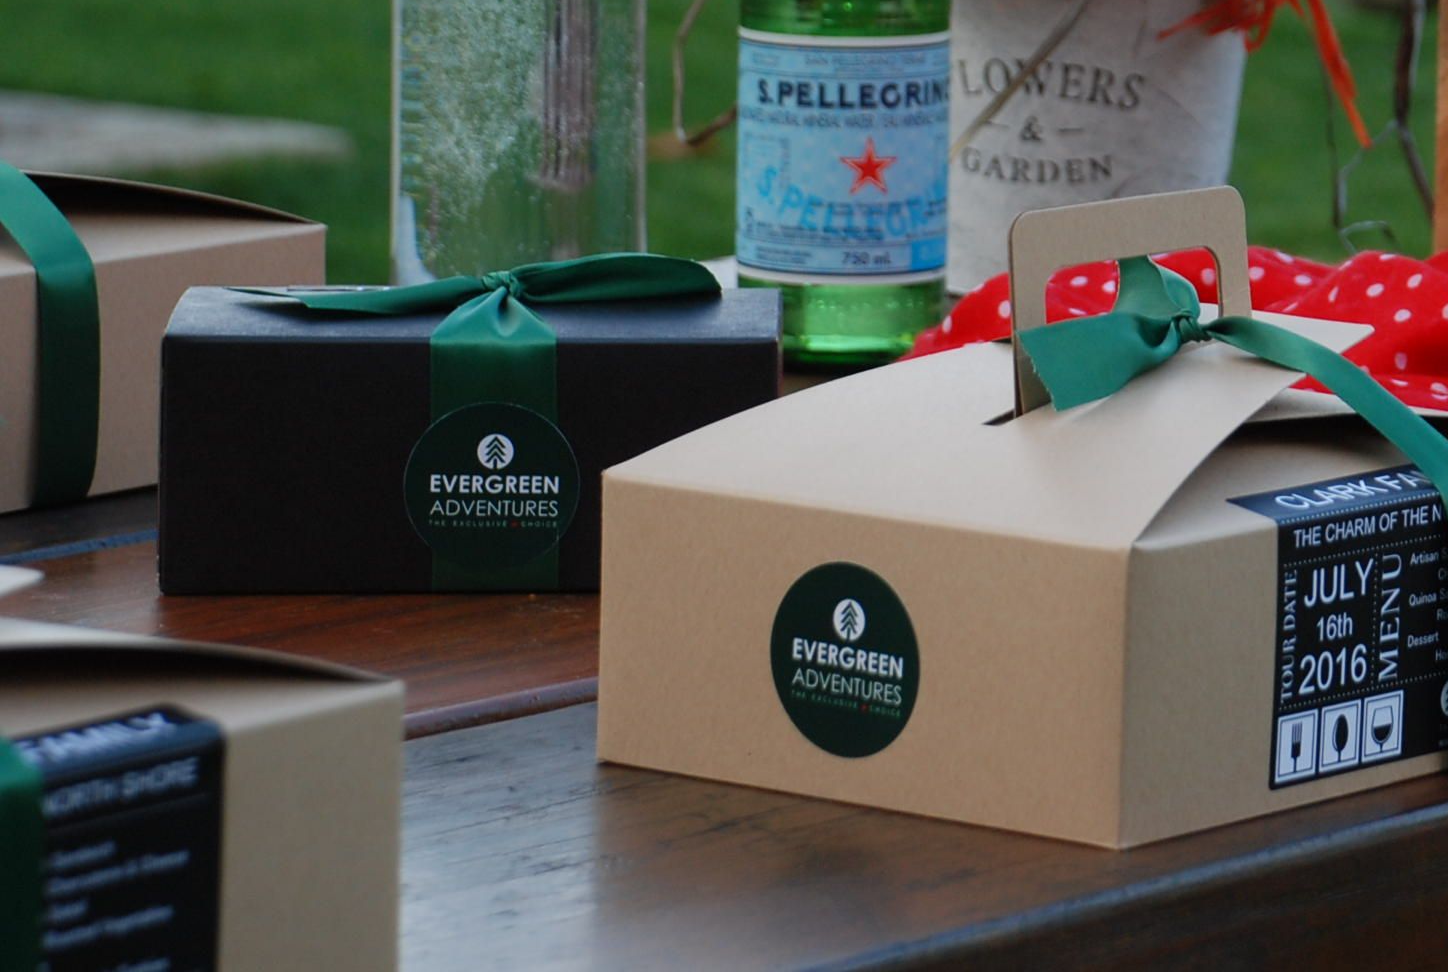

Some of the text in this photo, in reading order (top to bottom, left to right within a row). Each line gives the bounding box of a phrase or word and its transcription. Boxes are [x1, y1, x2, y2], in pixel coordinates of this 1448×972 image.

[1020, 116, 1041, 142] &
[961, 147, 1113, 183] GARDEN
[842, 250, 869, 265] 750
[429, 474, 560, 494] EVERGREEN
[1275, 478, 1389, 509] CLARK
[429, 499, 558, 517] ADVENTURES
[453, 519, 507, 527] EXCLUSIVE
[1294, 526, 1321, 548] THE
[1325, 515, 1376, 543] CHARM
[1379, 511, 1398, 532] OF
[1401, 505, 1429, 527] THE
[1410, 551, 1440, 565] Artisan
[1304, 558, 1374, 607] JULY
[1409, 592, 1437, 606] Quinoa
[1317, 612, 1354, 642] 16th
[1378, 553, 1402, 681] MENU
[1407, 632, 1439, 648] Dessert
[792, 637, 904, 678] EVERGREEN
[1280, 635, 1298, 703] TOUR
[1298, 644, 1367, 694] 2016
[792, 668, 902, 705] ADVENTURES
